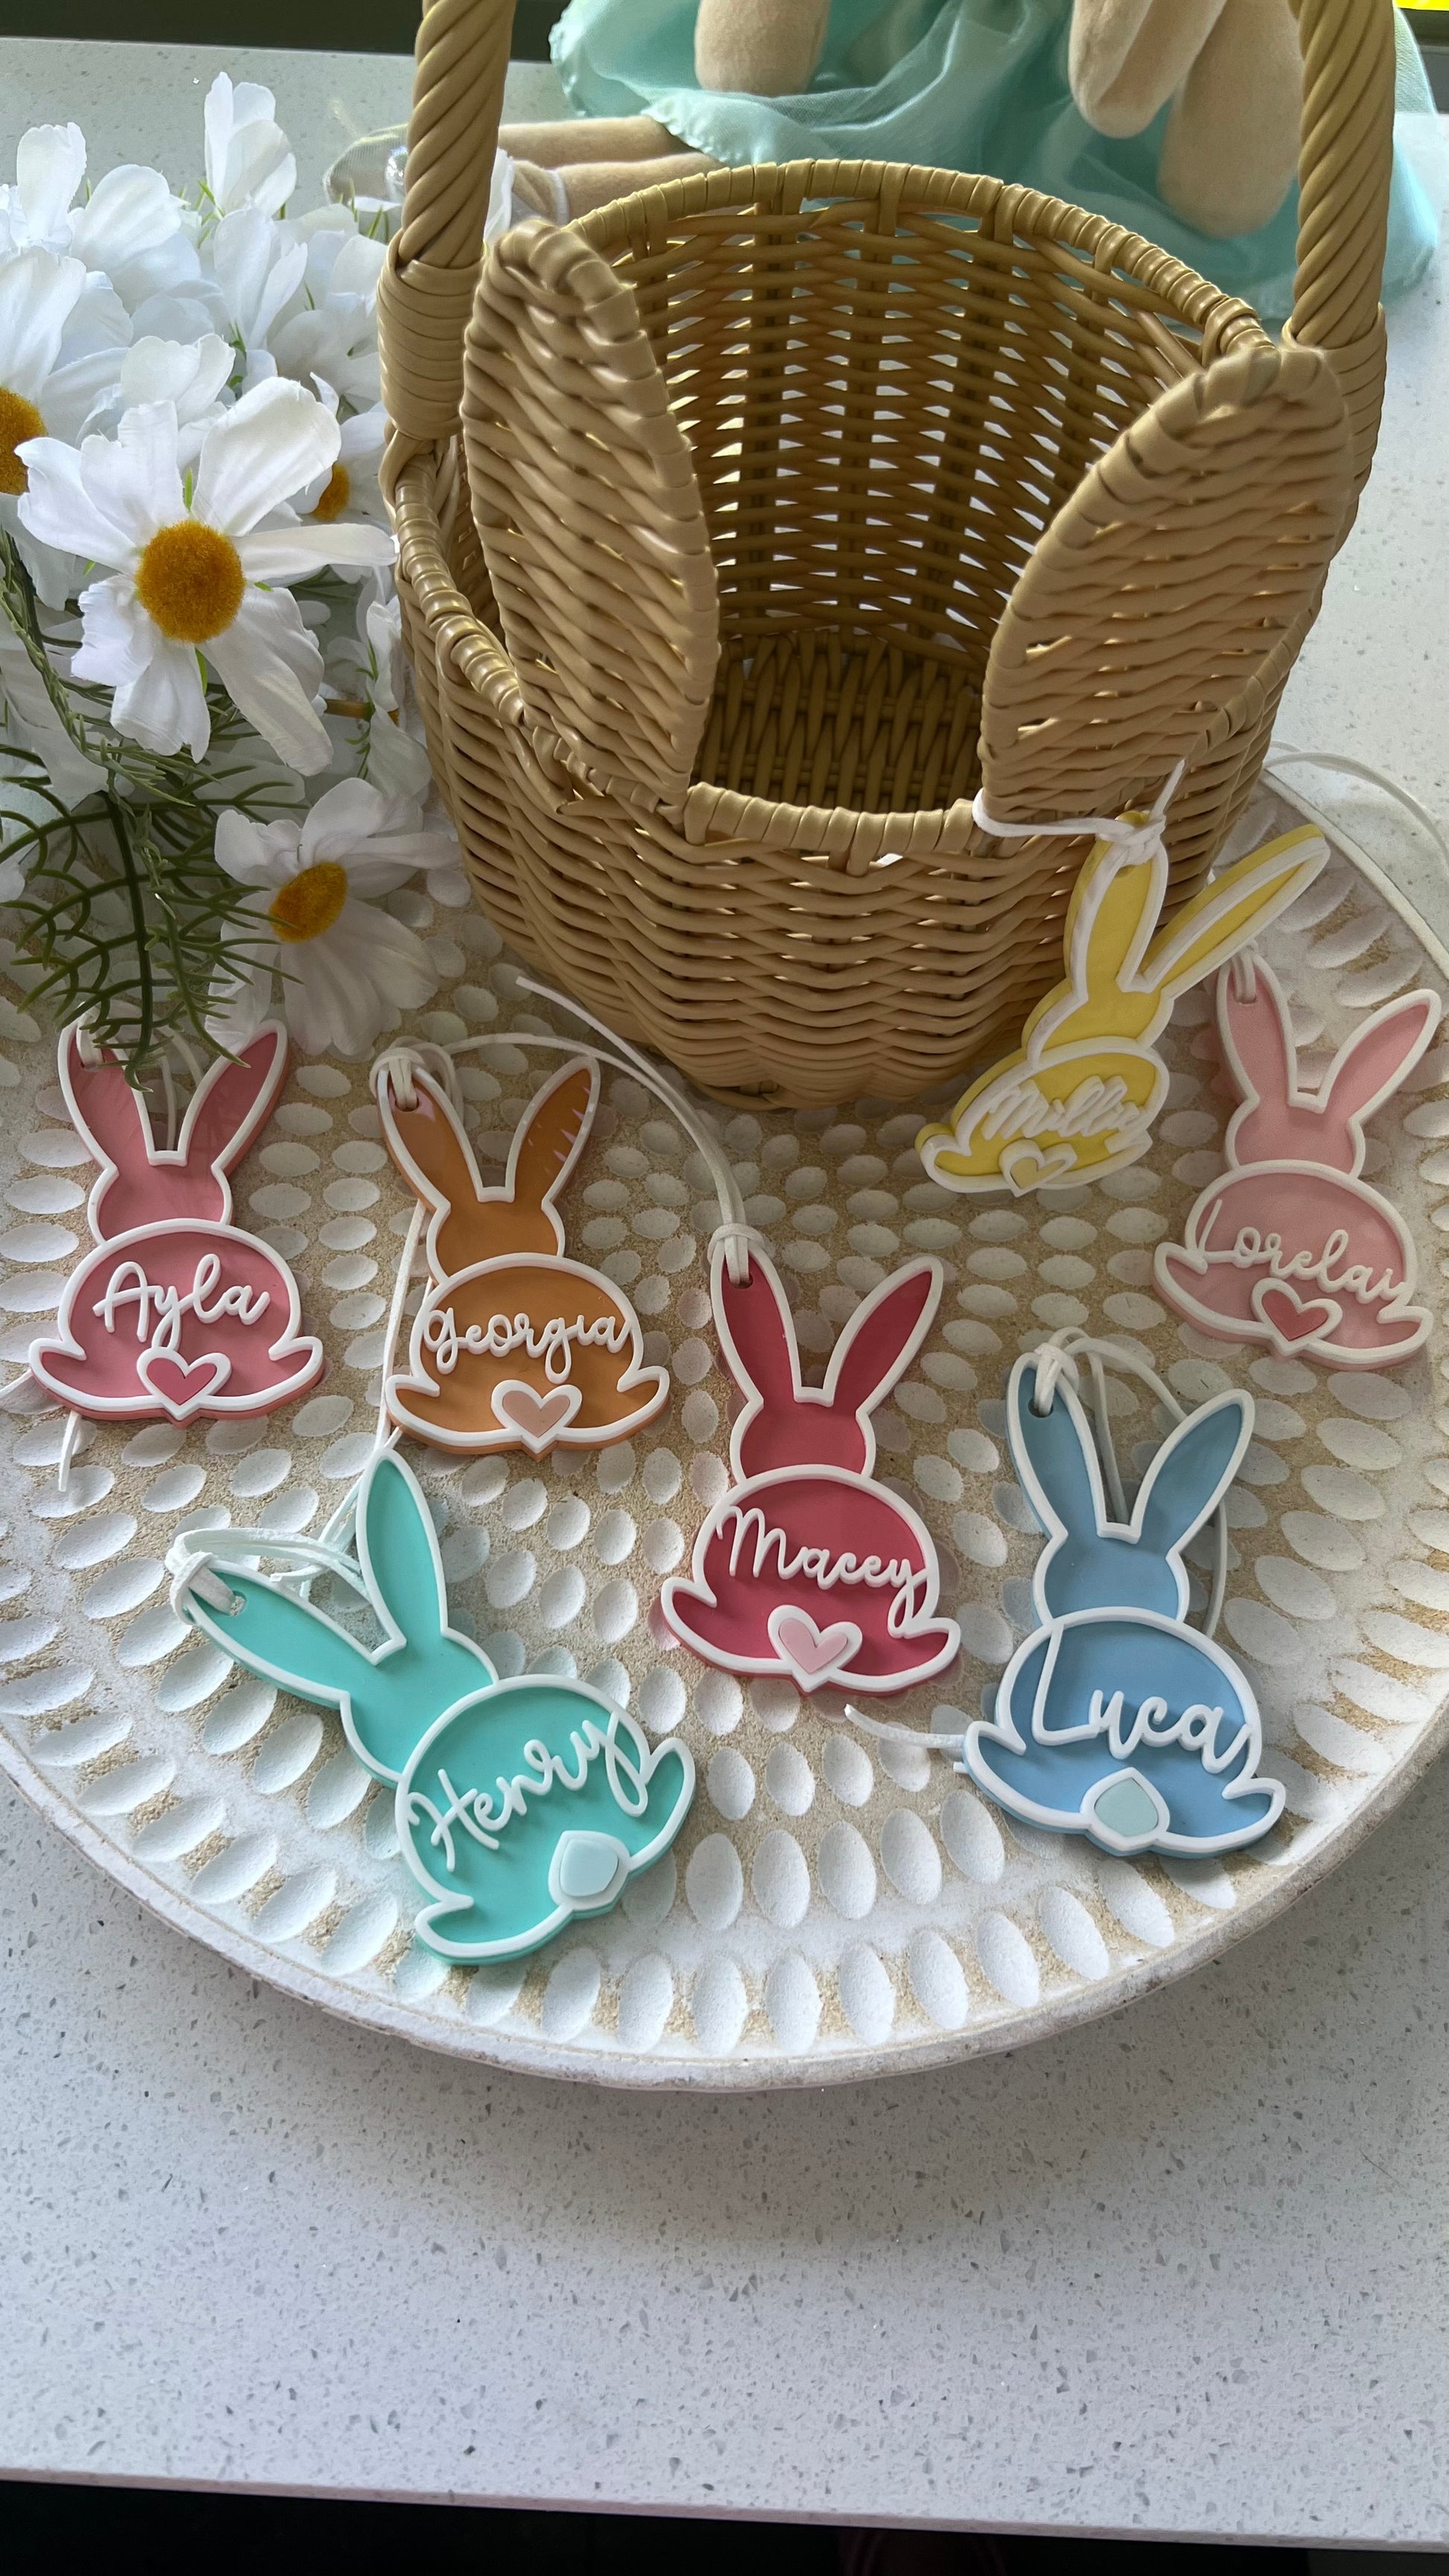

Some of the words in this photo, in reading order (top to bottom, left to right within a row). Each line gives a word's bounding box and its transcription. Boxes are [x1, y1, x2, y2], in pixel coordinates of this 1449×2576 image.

[92, 1252, 271, 1354] Ayla
[1196, 1198, 1407, 1304] Lorelai
[715, 1505, 928, 1639] Macey
[1031, 1622, 1252, 1774] Luca
[407, 1712, 649, 1872] Henry
